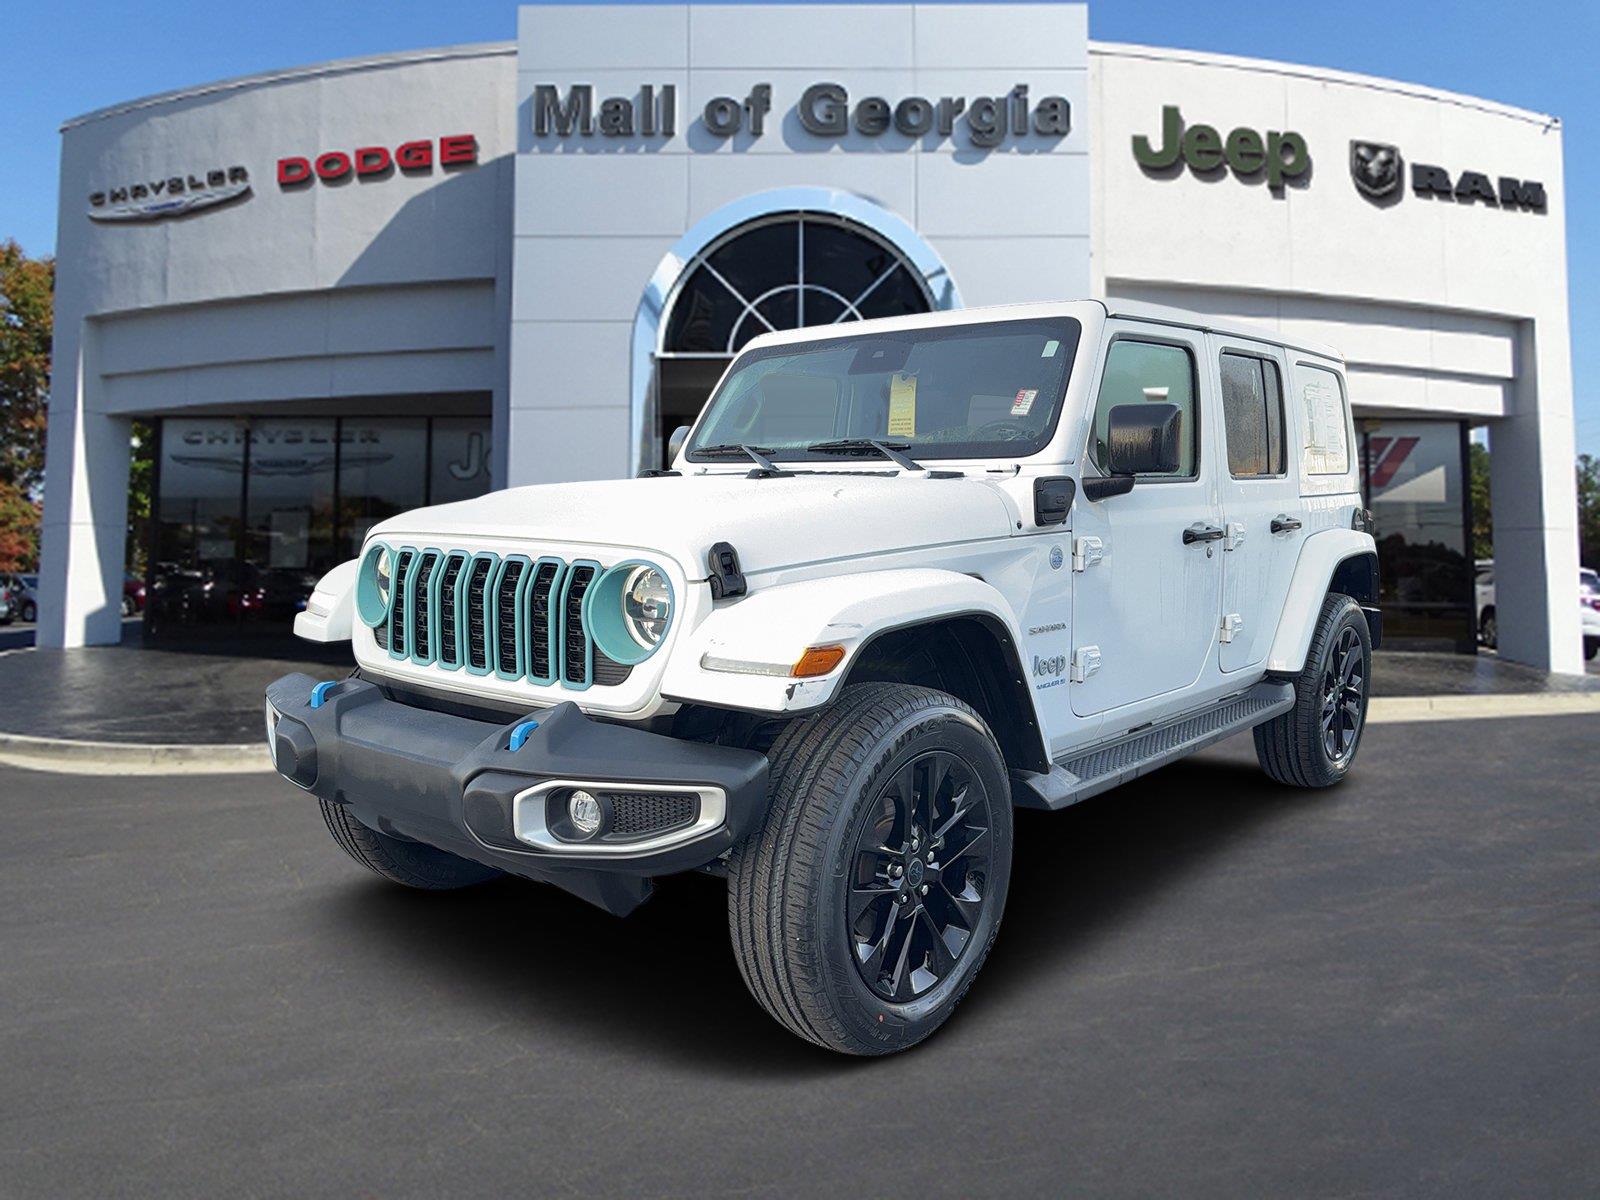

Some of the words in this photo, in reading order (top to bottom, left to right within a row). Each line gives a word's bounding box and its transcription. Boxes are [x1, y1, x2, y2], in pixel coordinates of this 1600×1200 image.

[532, 84, 677, 138] Mall
[703, 84, 772, 138] of
[799, 83, 1072, 149] Georgia
[277, 134, 476, 188] DODGE
[1131, 104, 1310, 195] Jeep
[90, 166, 248, 206] CHRYSLER
[1410, 162, 1548, 213] RAM
[182, 429, 381, 444] CHRYSLER
[1028, 622, 1067, 636] SAHARA
[1032, 654, 1067, 677] Jeep
